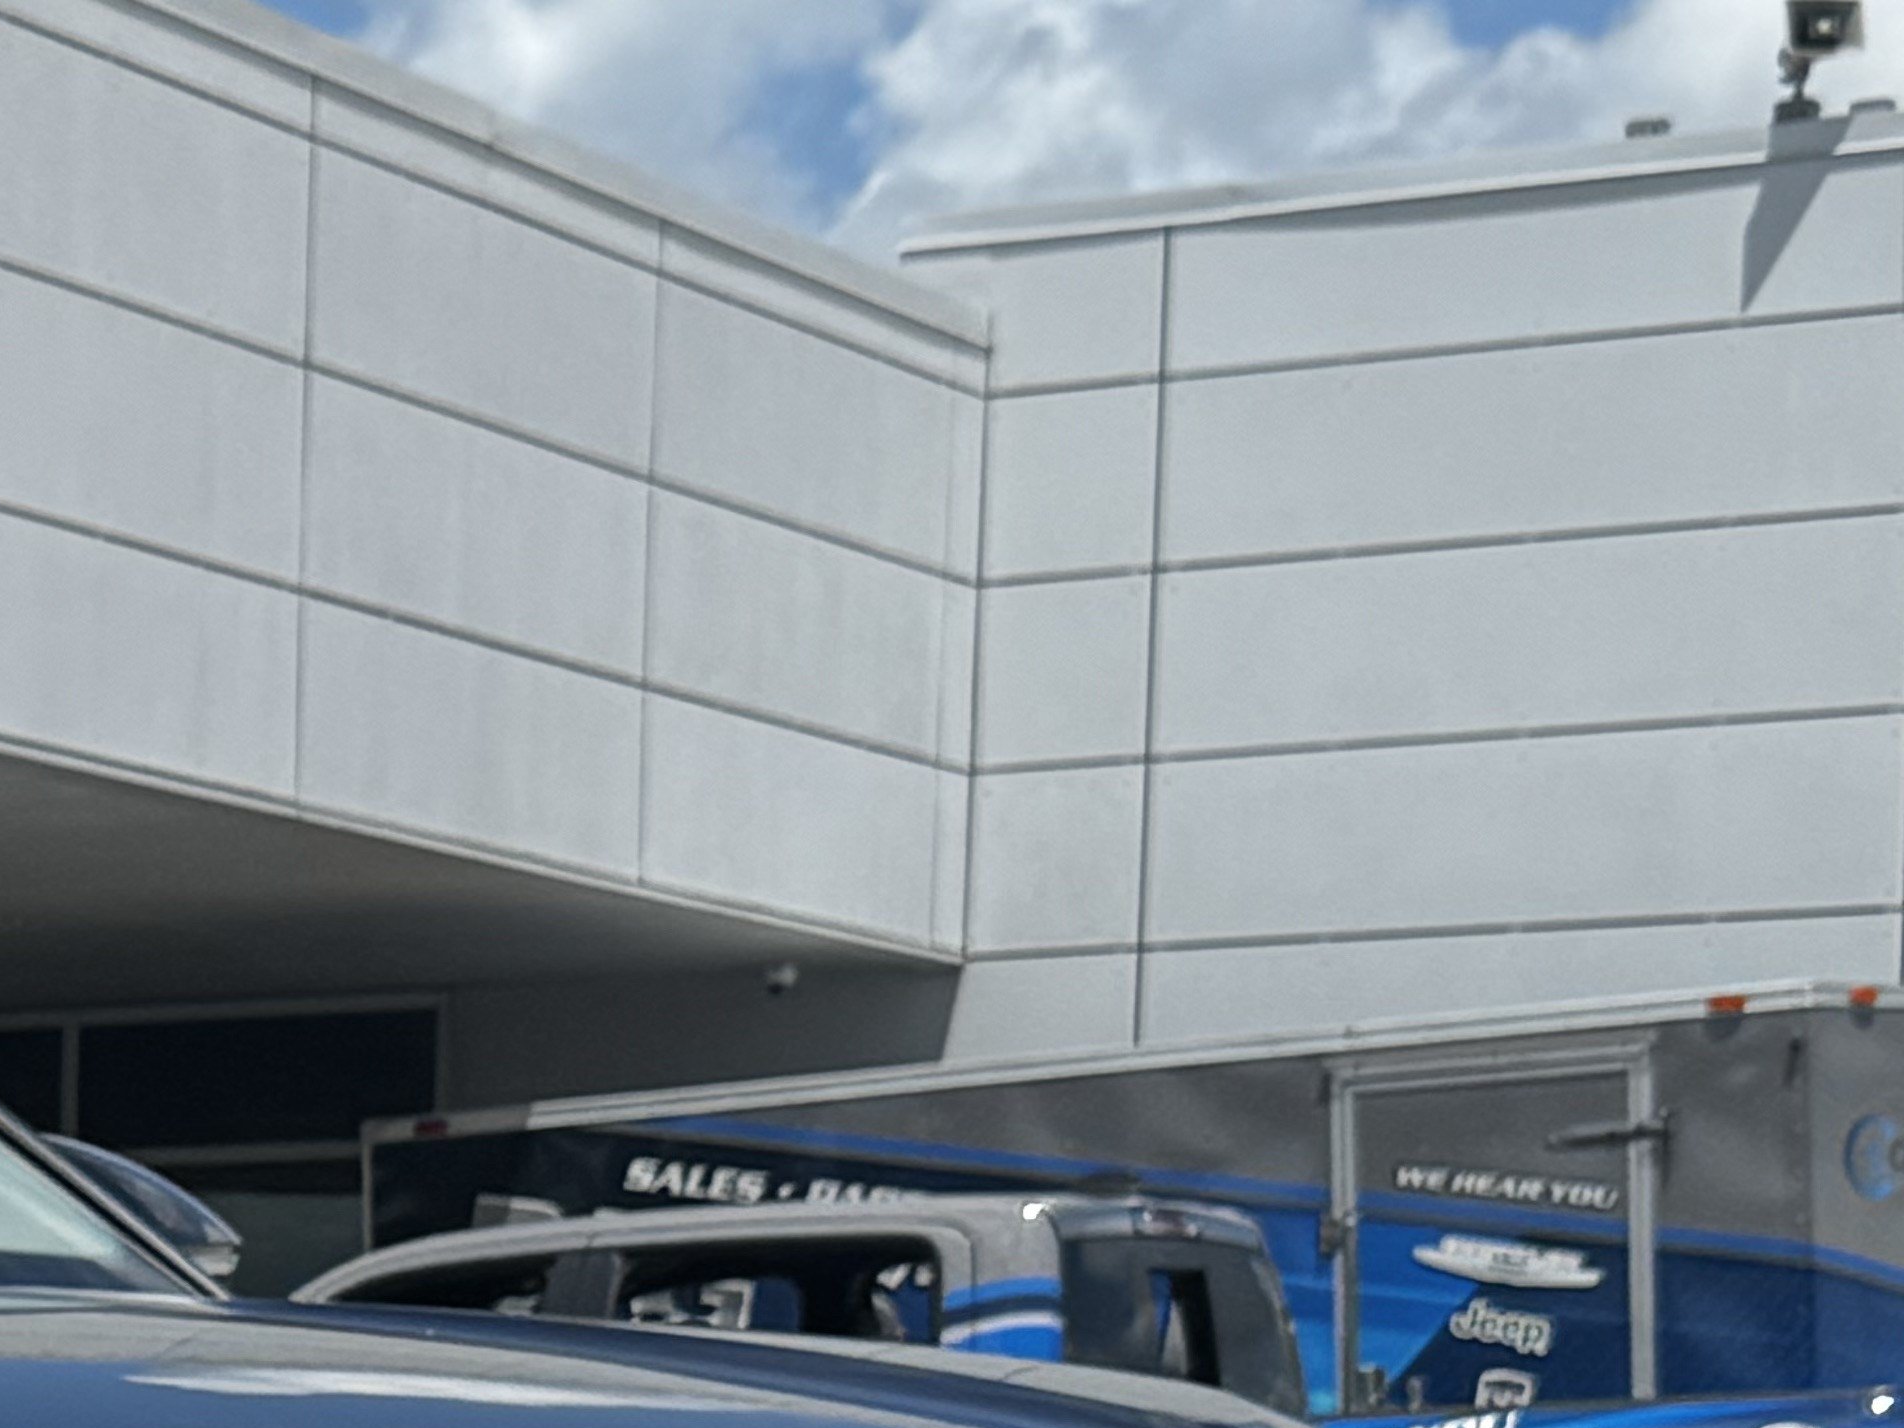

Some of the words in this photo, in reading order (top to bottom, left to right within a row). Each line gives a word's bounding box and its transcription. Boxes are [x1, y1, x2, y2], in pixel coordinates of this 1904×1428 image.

[623, 1156, 770, 1203] SALES
[1396, 1165, 1449, 1191] WE
[1450, 1170, 1546, 1201] HEAR
[1549, 1179, 1619, 1210] YOU
[1450, 1298, 1550, 1357] Jeep
